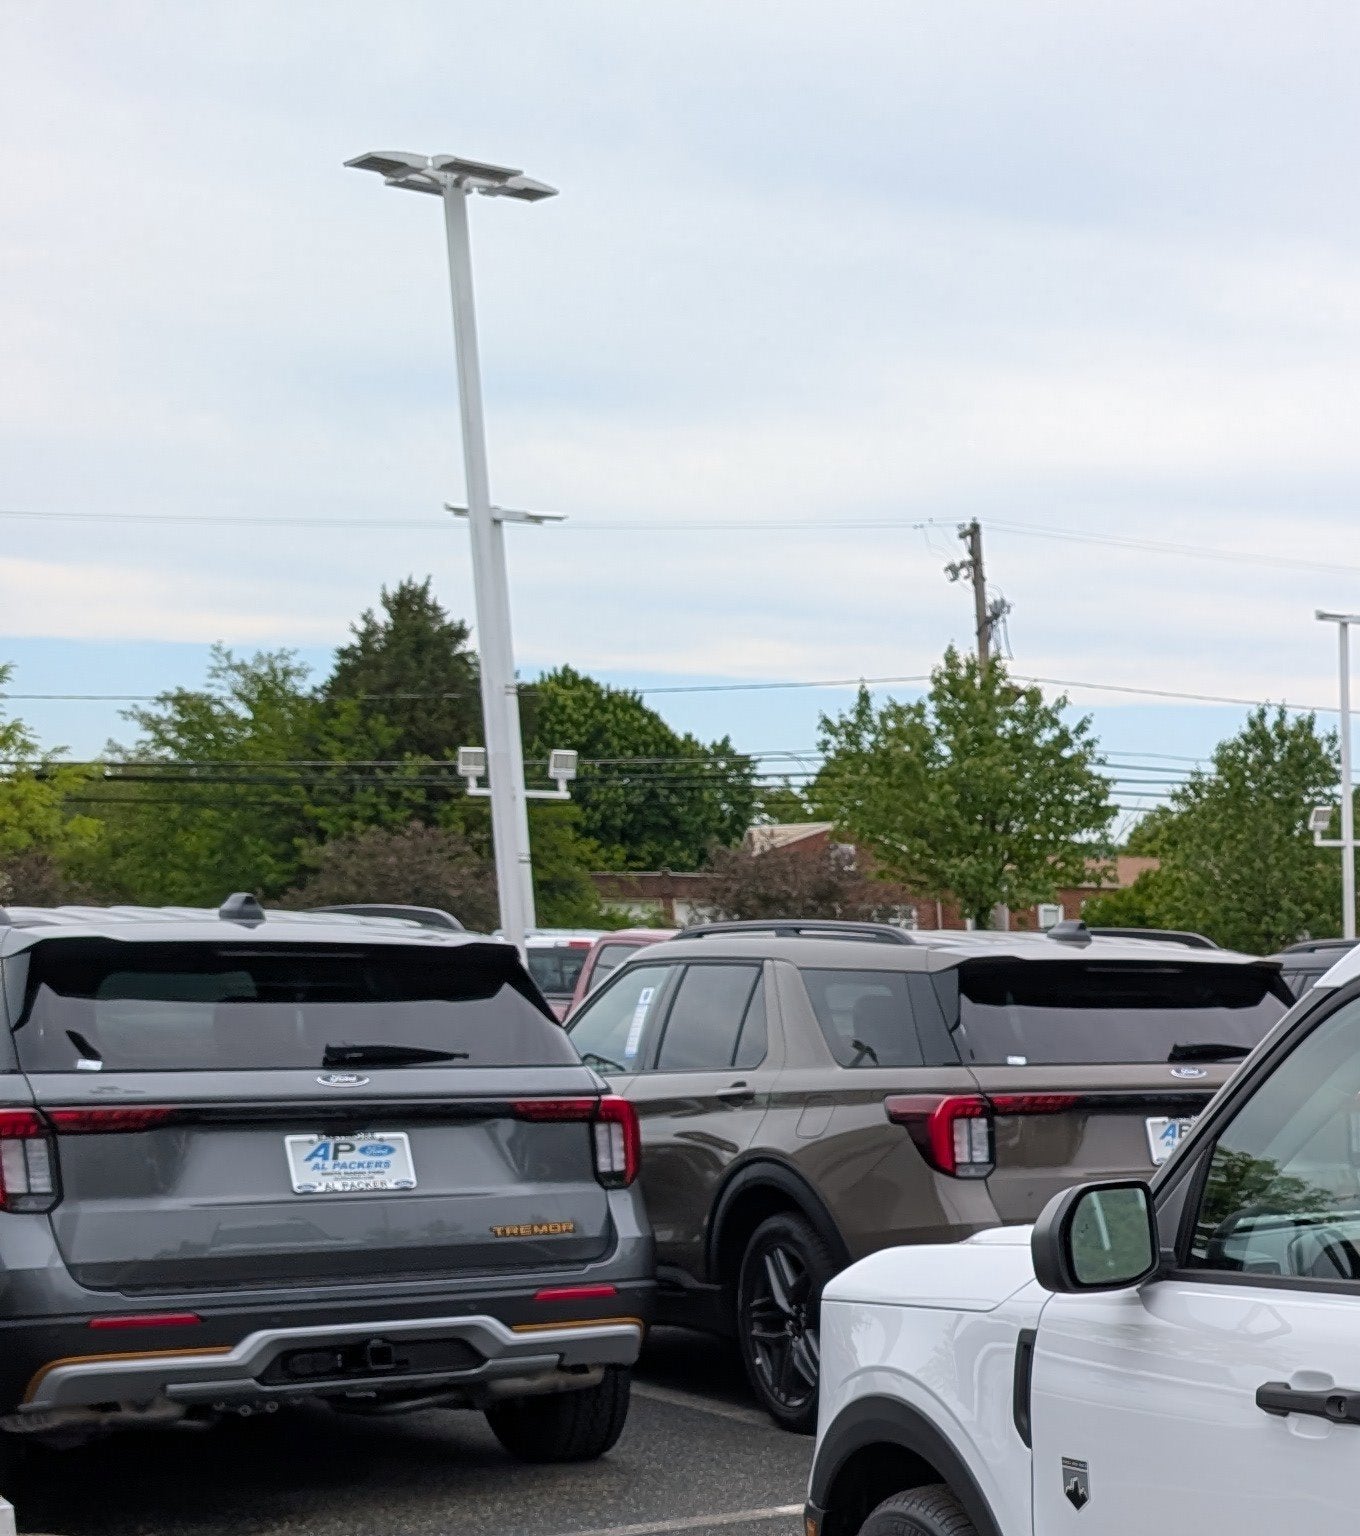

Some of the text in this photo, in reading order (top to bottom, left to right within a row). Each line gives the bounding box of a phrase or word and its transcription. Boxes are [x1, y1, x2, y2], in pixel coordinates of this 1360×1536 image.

[304, 1142, 356, 1162] AP
[311, 1160, 391, 1171] AL PACKERS
[490, 1222, 575, 1238] TREMOR
